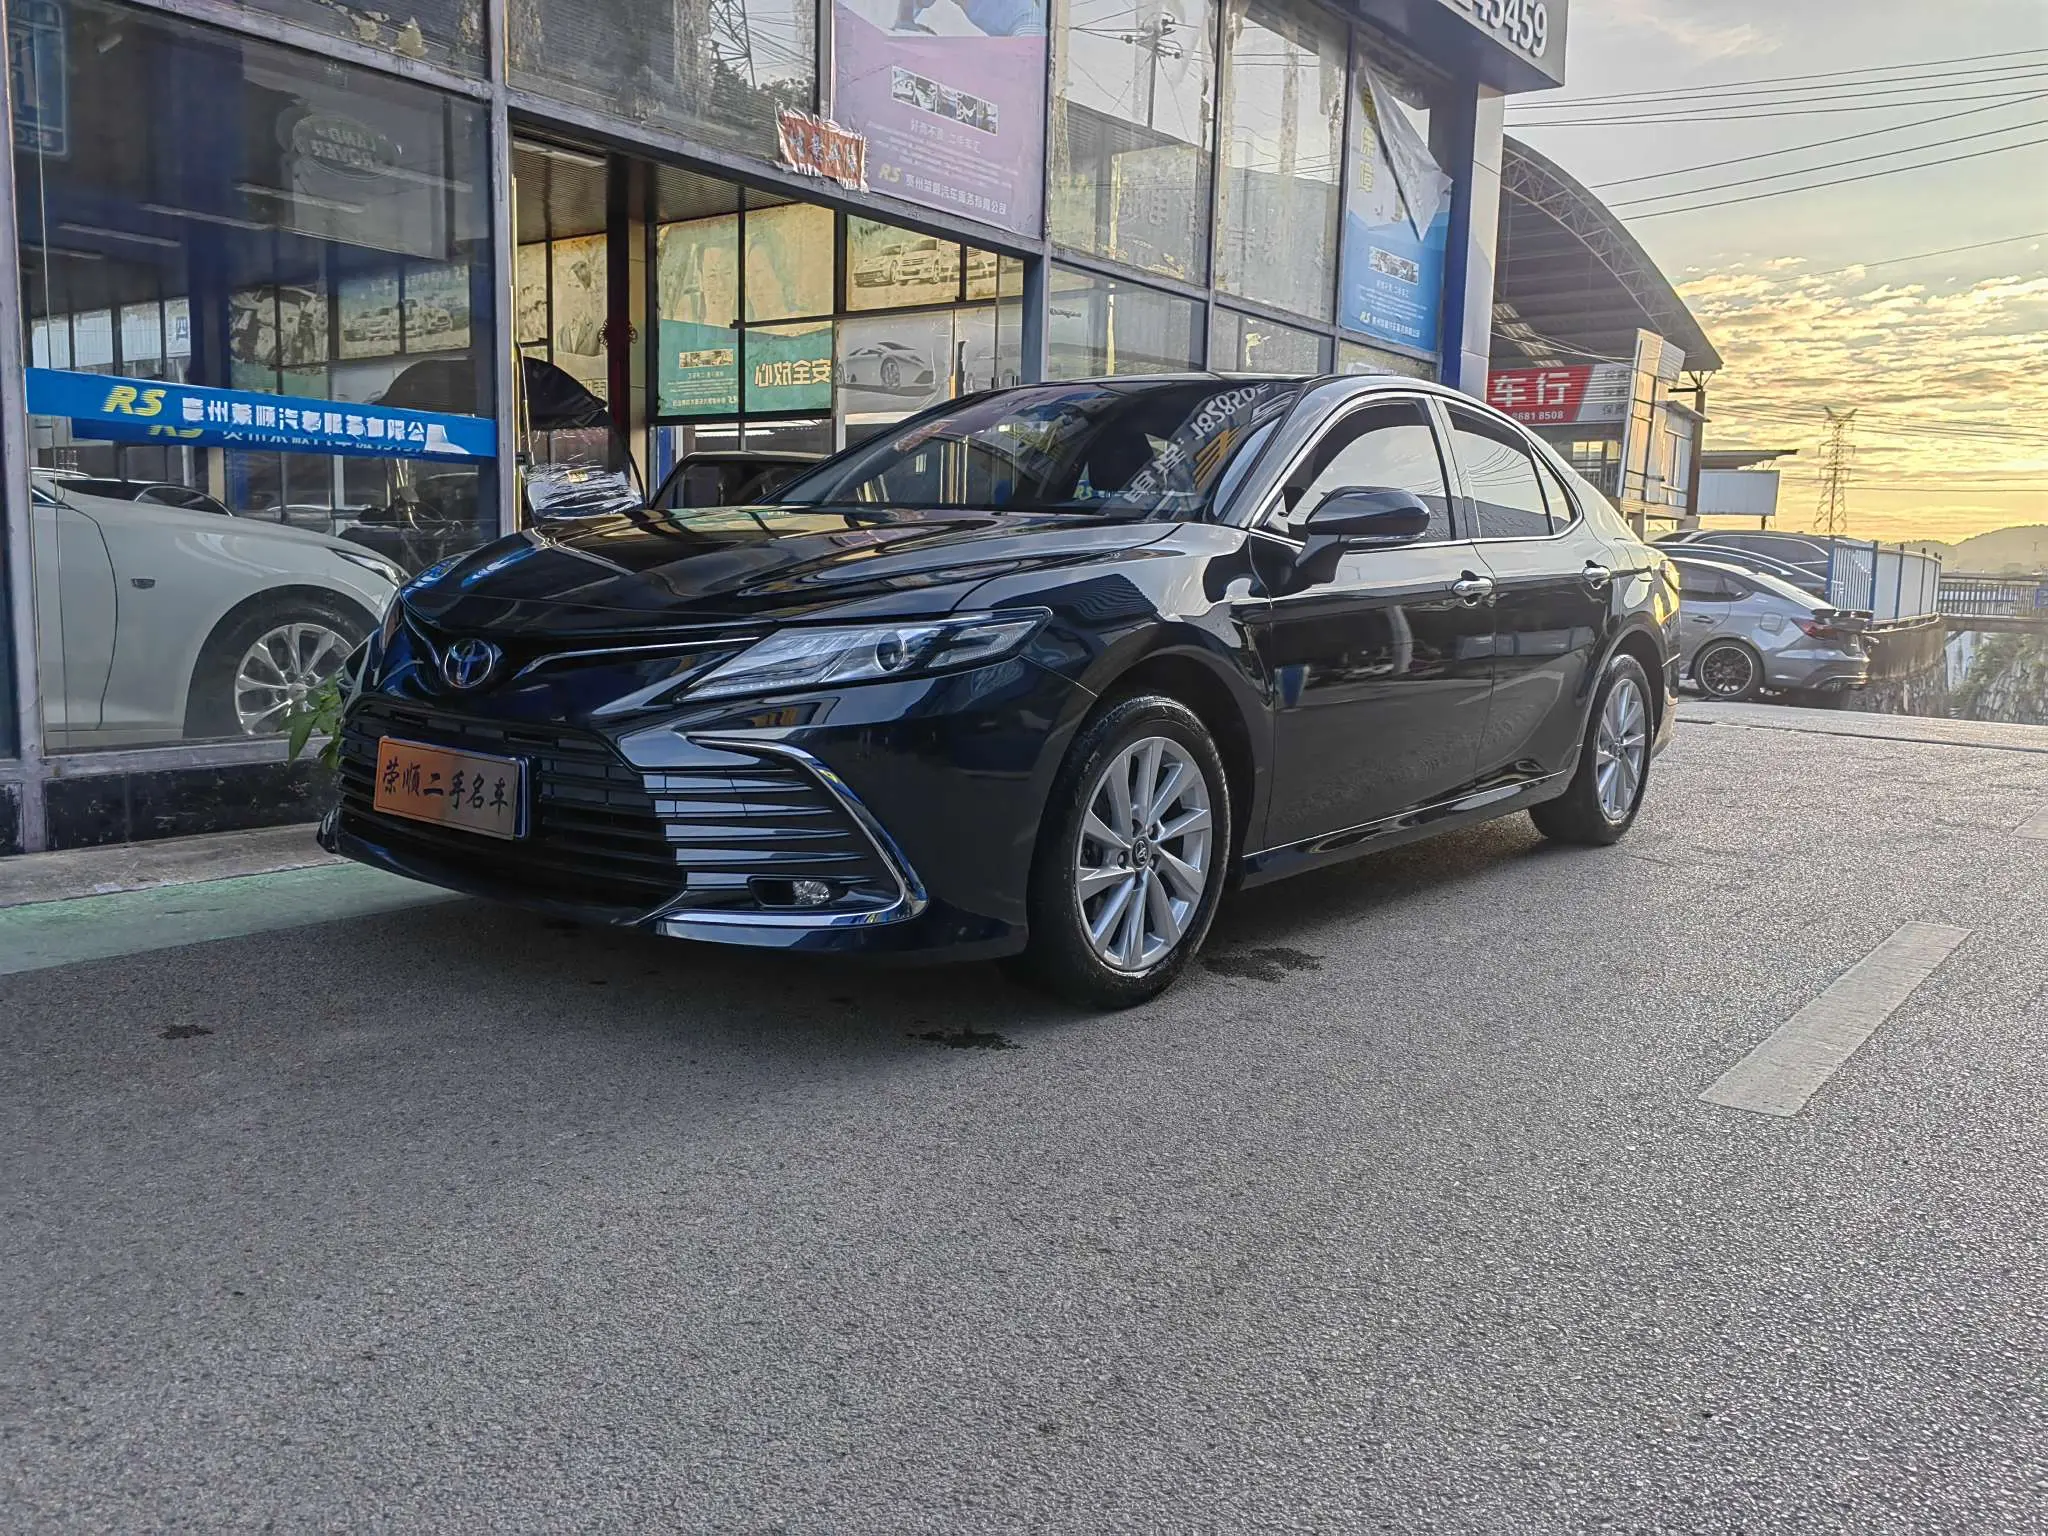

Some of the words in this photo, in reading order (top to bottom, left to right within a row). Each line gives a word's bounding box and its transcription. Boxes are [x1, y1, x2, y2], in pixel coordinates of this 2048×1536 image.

[878, 163, 901, 183] RS
[102, 385, 166, 417] RS
[1491, 372, 1571, 407] 车行
